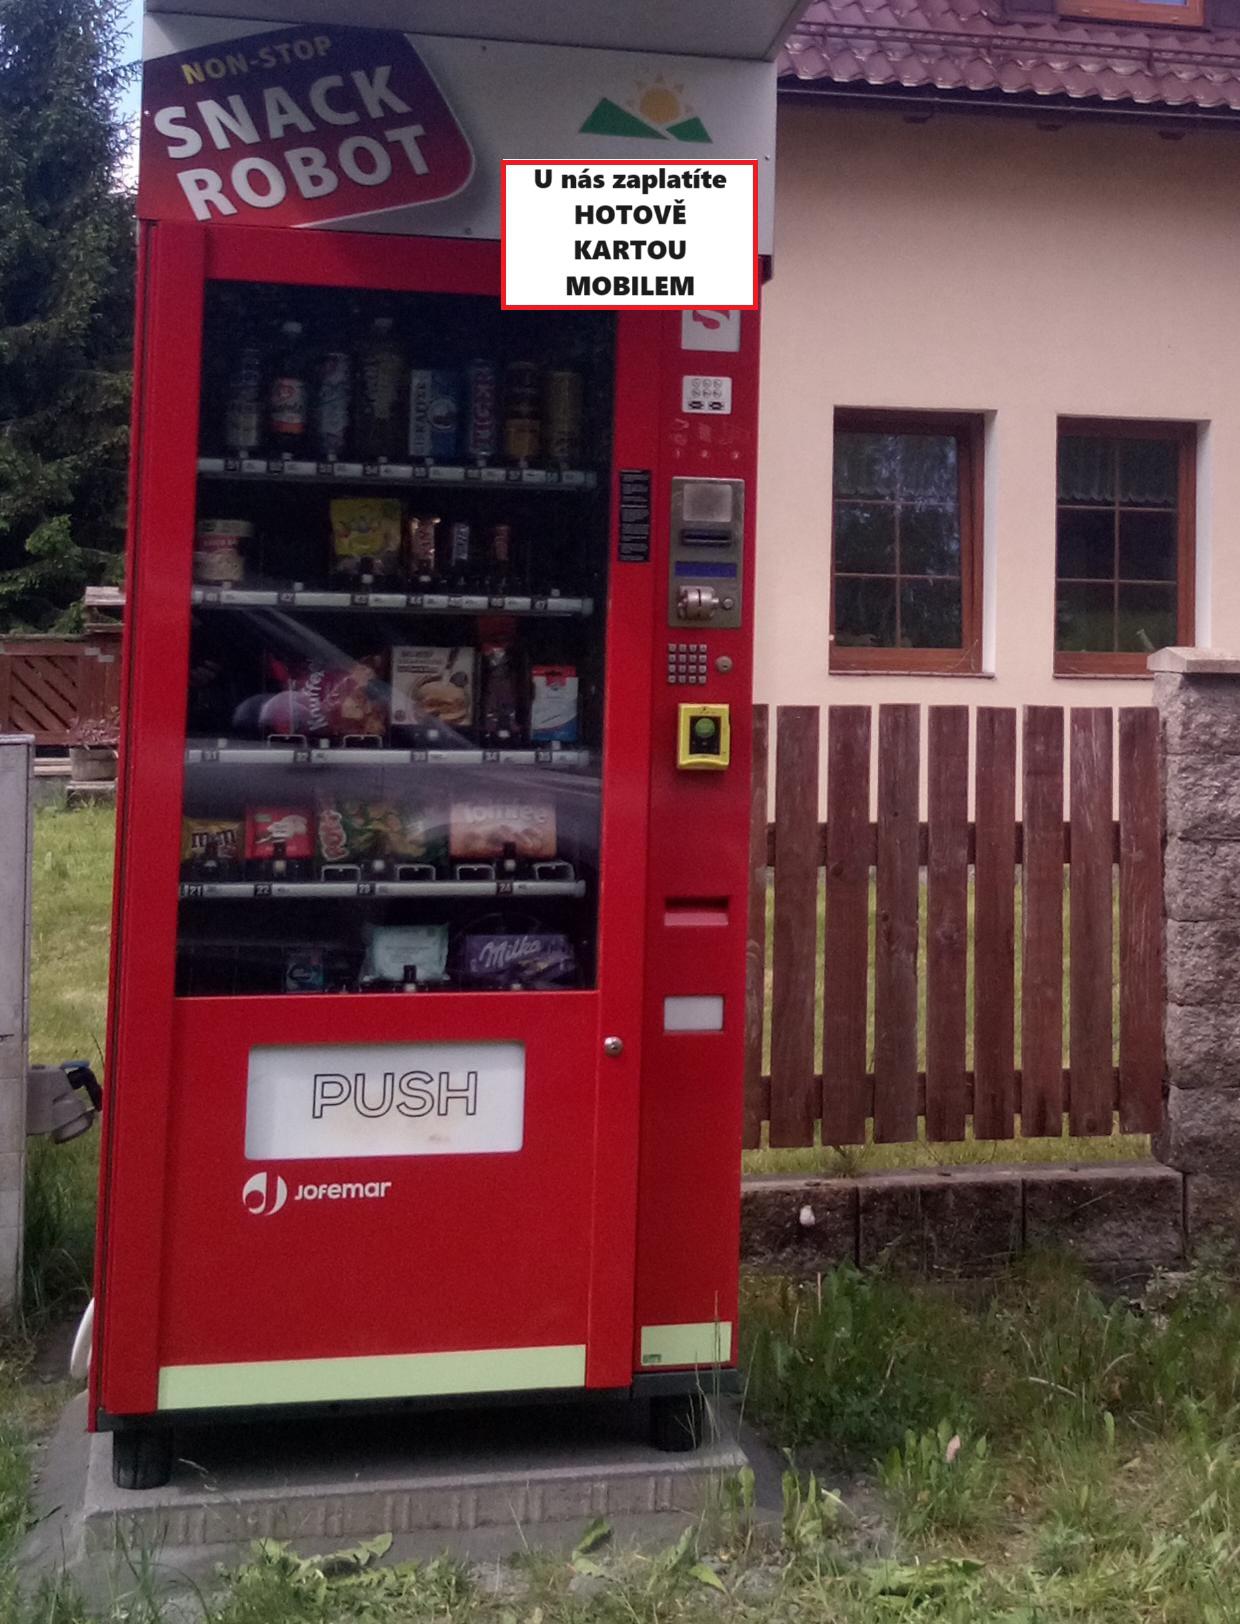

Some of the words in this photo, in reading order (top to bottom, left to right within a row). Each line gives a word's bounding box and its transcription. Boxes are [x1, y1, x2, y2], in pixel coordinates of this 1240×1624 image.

[180, 35, 332, 85] NON-STOP
[153, 64, 413, 159] SNACK
[176, 123, 430, 221] ROBOT
[478, 935, 542, 969] Milka
[312, 1070, 478, 1119] PUSH
